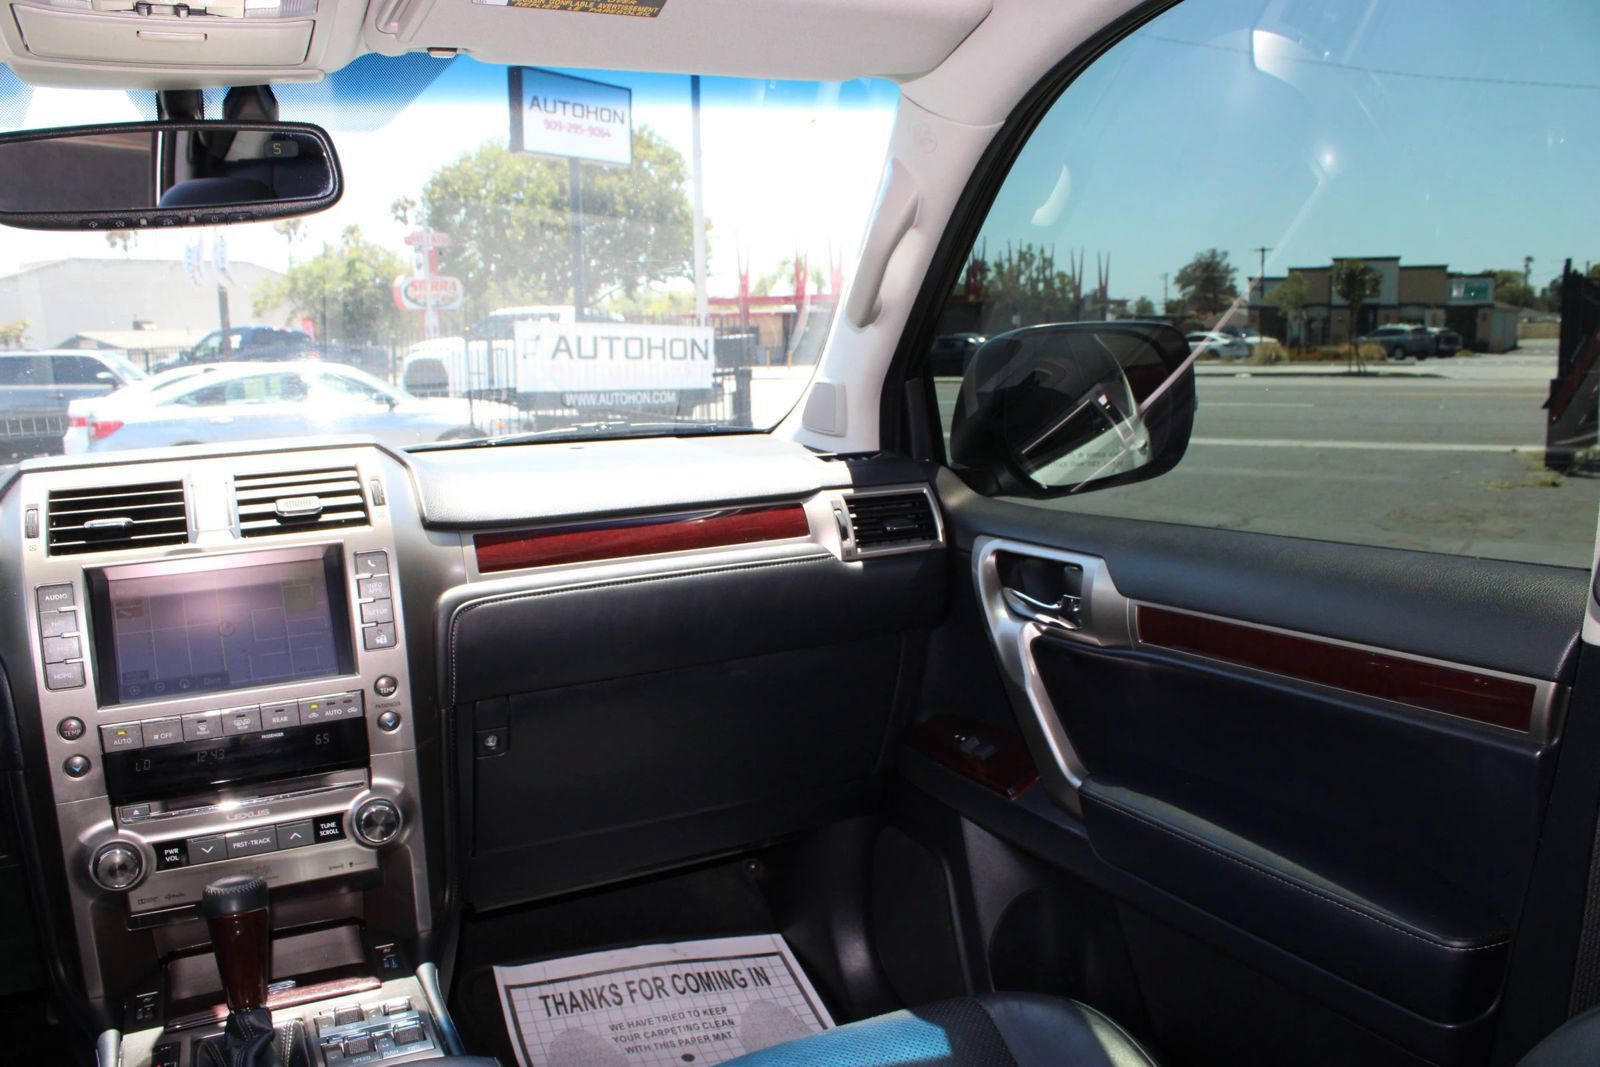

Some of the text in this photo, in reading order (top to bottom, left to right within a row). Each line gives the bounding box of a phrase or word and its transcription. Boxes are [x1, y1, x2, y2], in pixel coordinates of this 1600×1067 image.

[597, 3, 660, 12] AVERTISSEMENT
[529, 95, 625, 124] AUTOHON
[551, 335, 709, 361] AUTOHON
[563, 390, 677, 407] WWW.AUTOHON.COM
[44, 593, 68, 601] AUDIO
[379, 686, 395, 694] TEMP
[325, 708, 343, 717] AUTO
[272, 715, 289, 723] REAR
[160, 732, 173, 740] OFF
[113, 737, 133, 746] AUTO
[226, 808, 271, 822] LEXUS
[320, 822, 337, 830] TUNE
[319, 828, 340, 837] SCROLL
[164, 847, 179, 855] PWR
[165, 855, 180, 863] VOL
[538, 966, 772, 1018] THANKS FOR COMING IN
[608, 1006, 728, 1032] WE HAVE TRIED TO KEEP
[612, 1018, 736, 1044] YOUR CARPETING CLEAN
[624, 1031, 733, 1055] WITH THIS PAPER MAT
